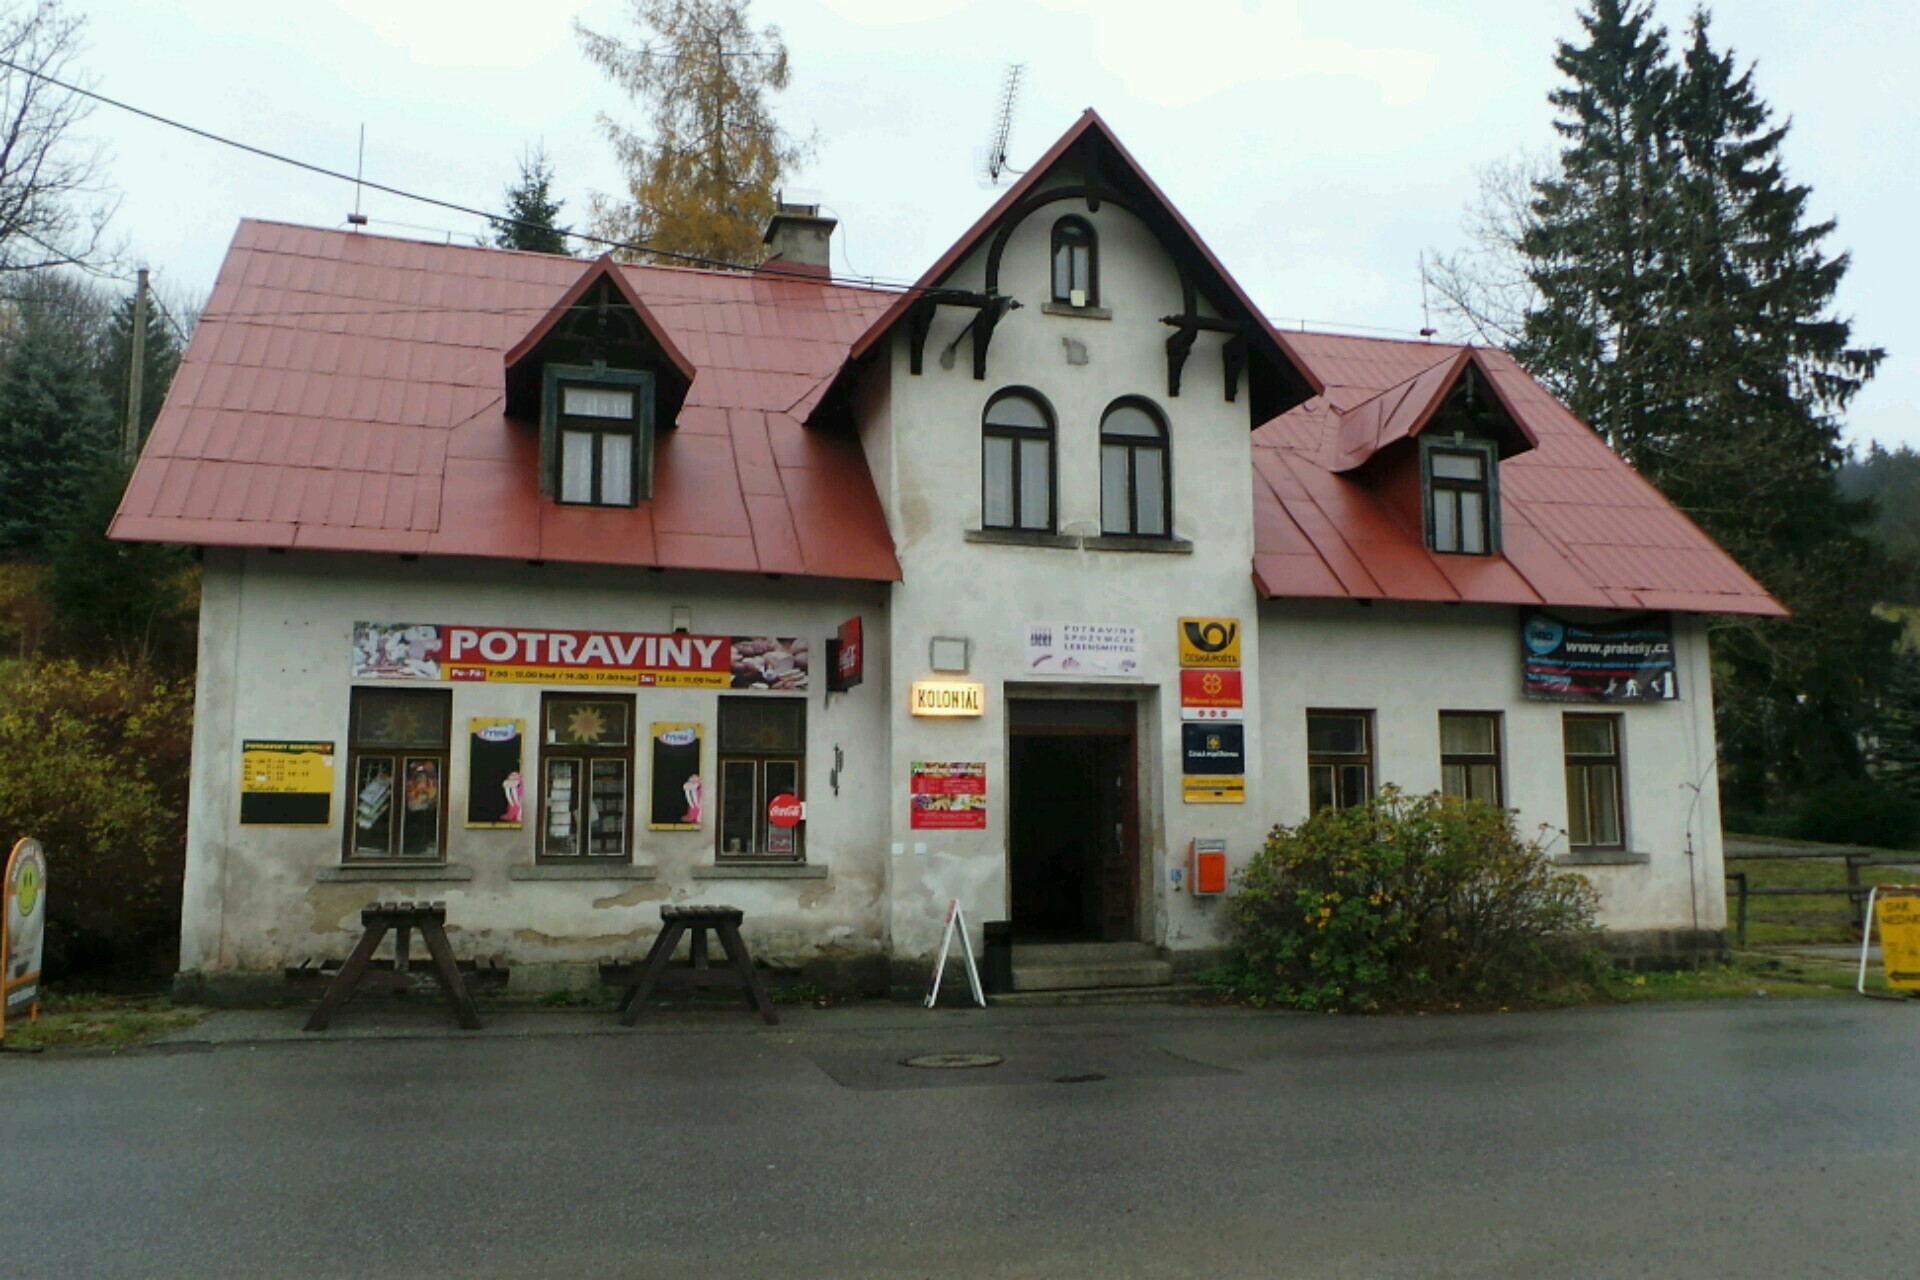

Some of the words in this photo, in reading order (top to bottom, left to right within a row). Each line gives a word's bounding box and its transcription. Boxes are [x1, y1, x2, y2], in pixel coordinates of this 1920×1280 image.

[1064, 625, 1135, 634] POTRAVINY
[450, 629, 722, 669] POTRAVINY
[1064, 643, 1136, 652] LEBENSMITTEL
[918, 687, 978, 710] KOLONIÁL
